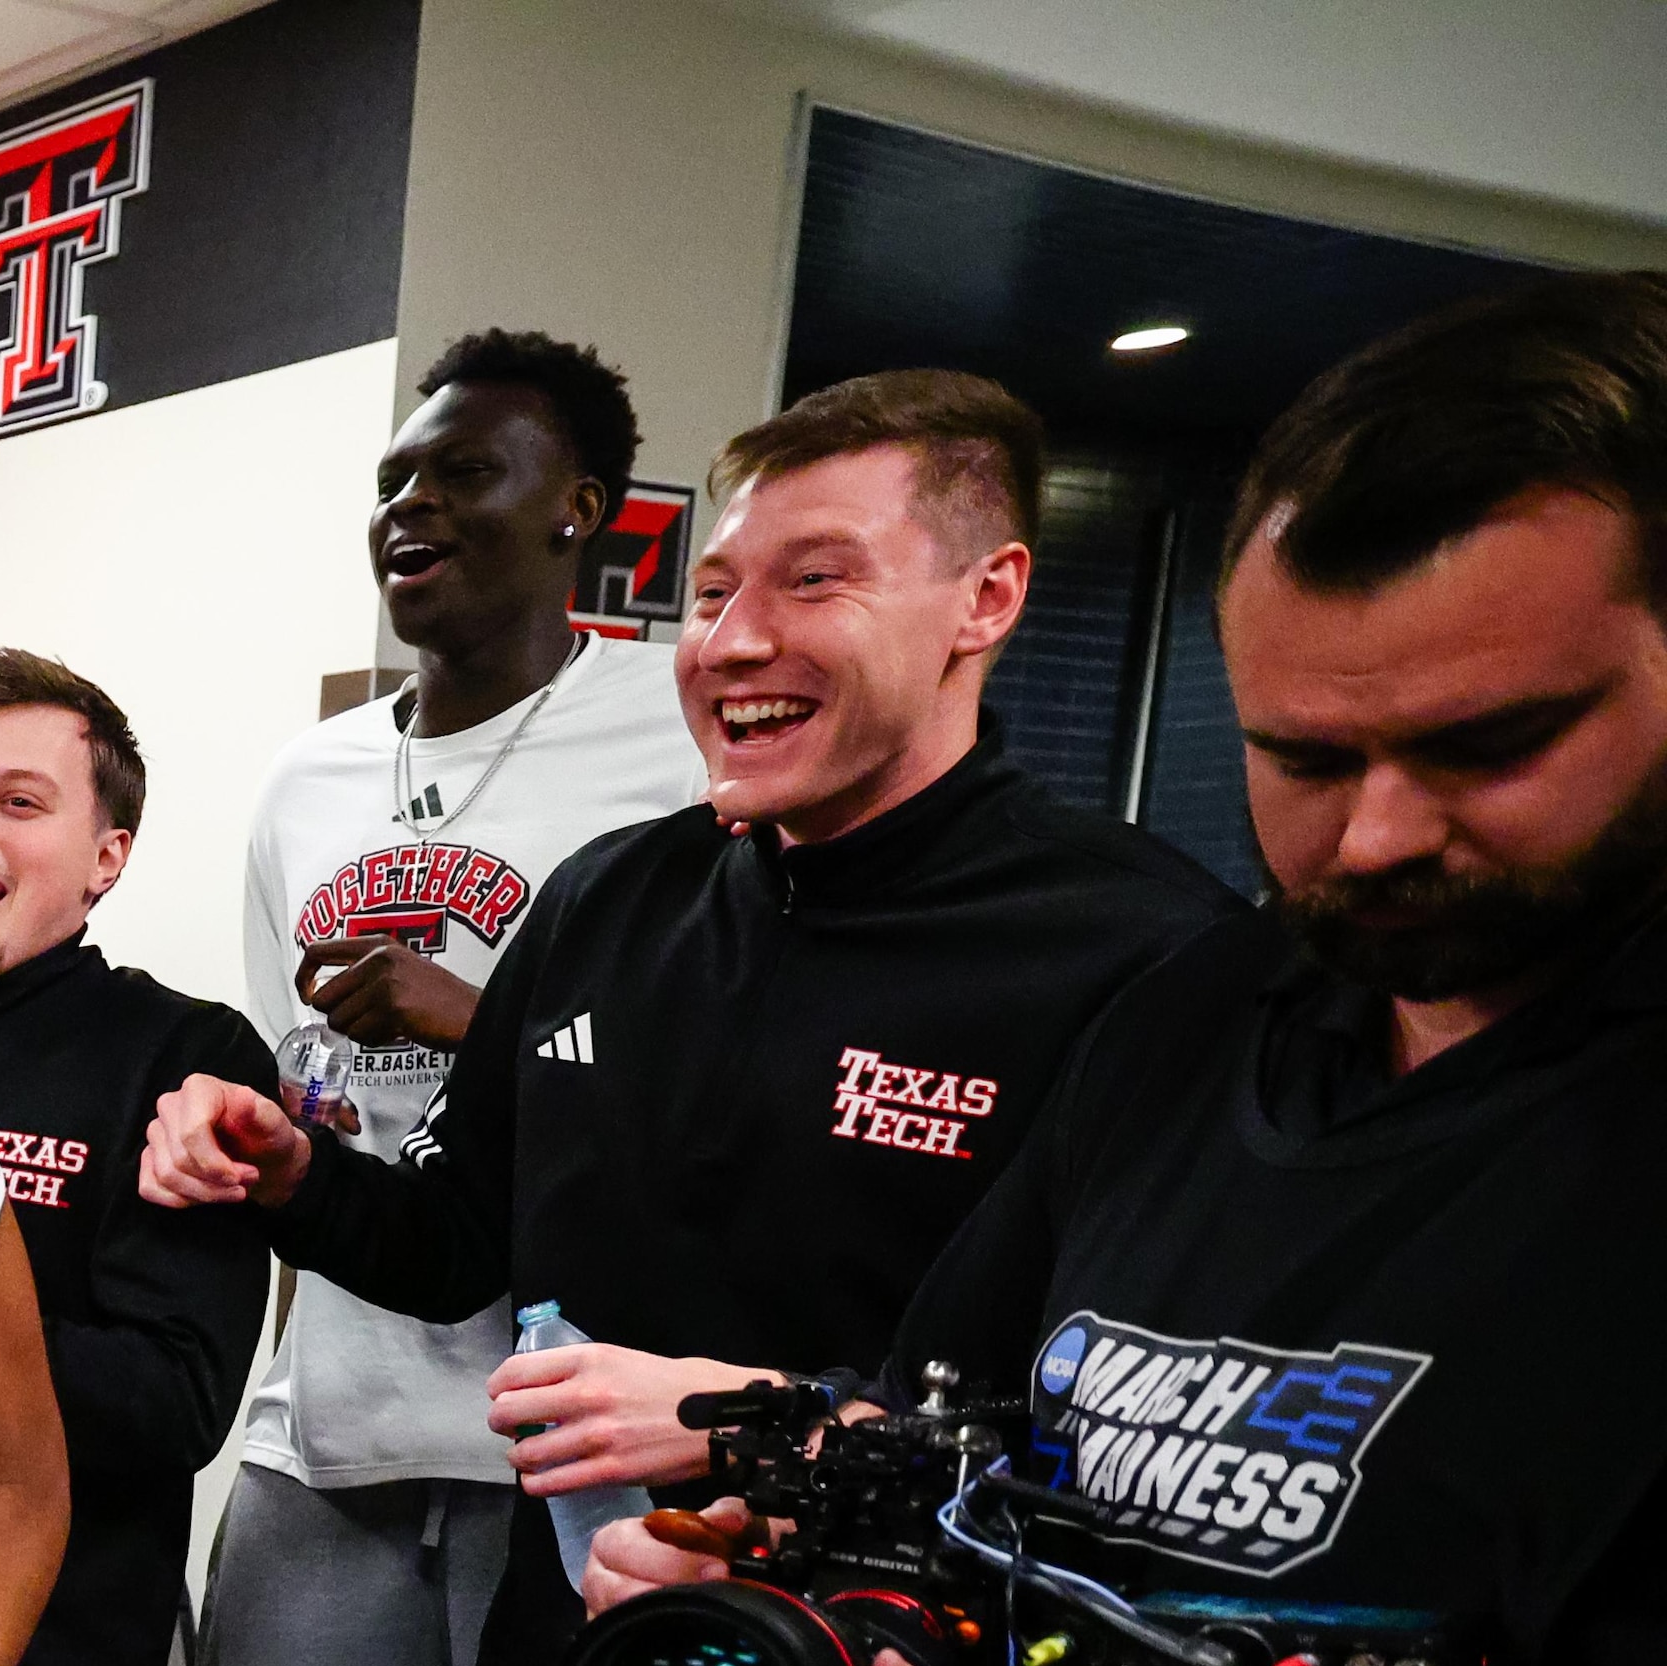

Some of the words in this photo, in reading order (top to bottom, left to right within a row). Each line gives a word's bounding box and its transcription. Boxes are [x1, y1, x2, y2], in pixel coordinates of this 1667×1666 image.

[296, 843, 530, 950] TOGETHER
[831, 1091, 966, 1156] TECH
[835, 1046, 998, 1116] TEXAS
[1071, 1337, 1271, 1435] MARCH
[1077, 1418, 1341, 1541] MADNESS
